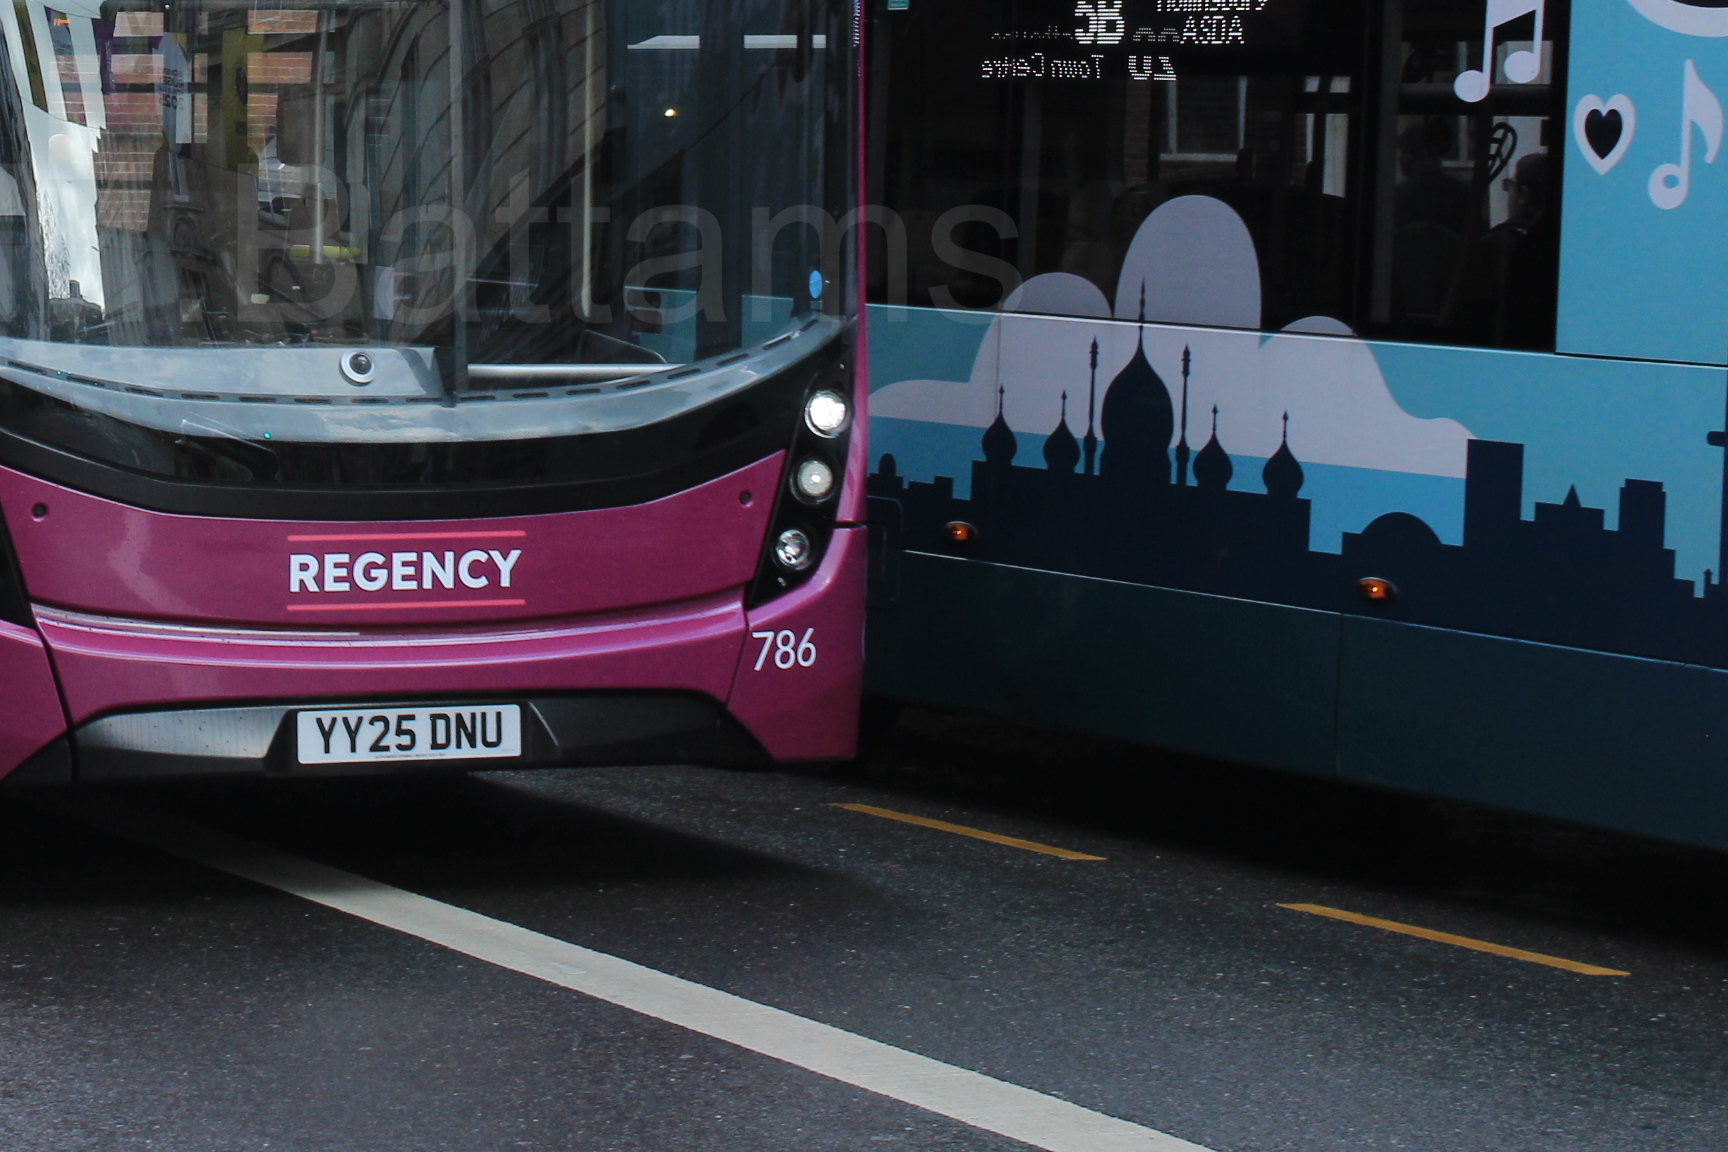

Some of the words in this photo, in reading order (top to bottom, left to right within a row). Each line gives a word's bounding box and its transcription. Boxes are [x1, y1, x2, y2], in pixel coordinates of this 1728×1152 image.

[1179, 15, 1245, 44] ASDA
[289, 549, 522, 593] REGENCY
[752, 627, 817, 671] 786
[316, 714, 416, 755] YY25
[429, 711, 503, 751] DNU
